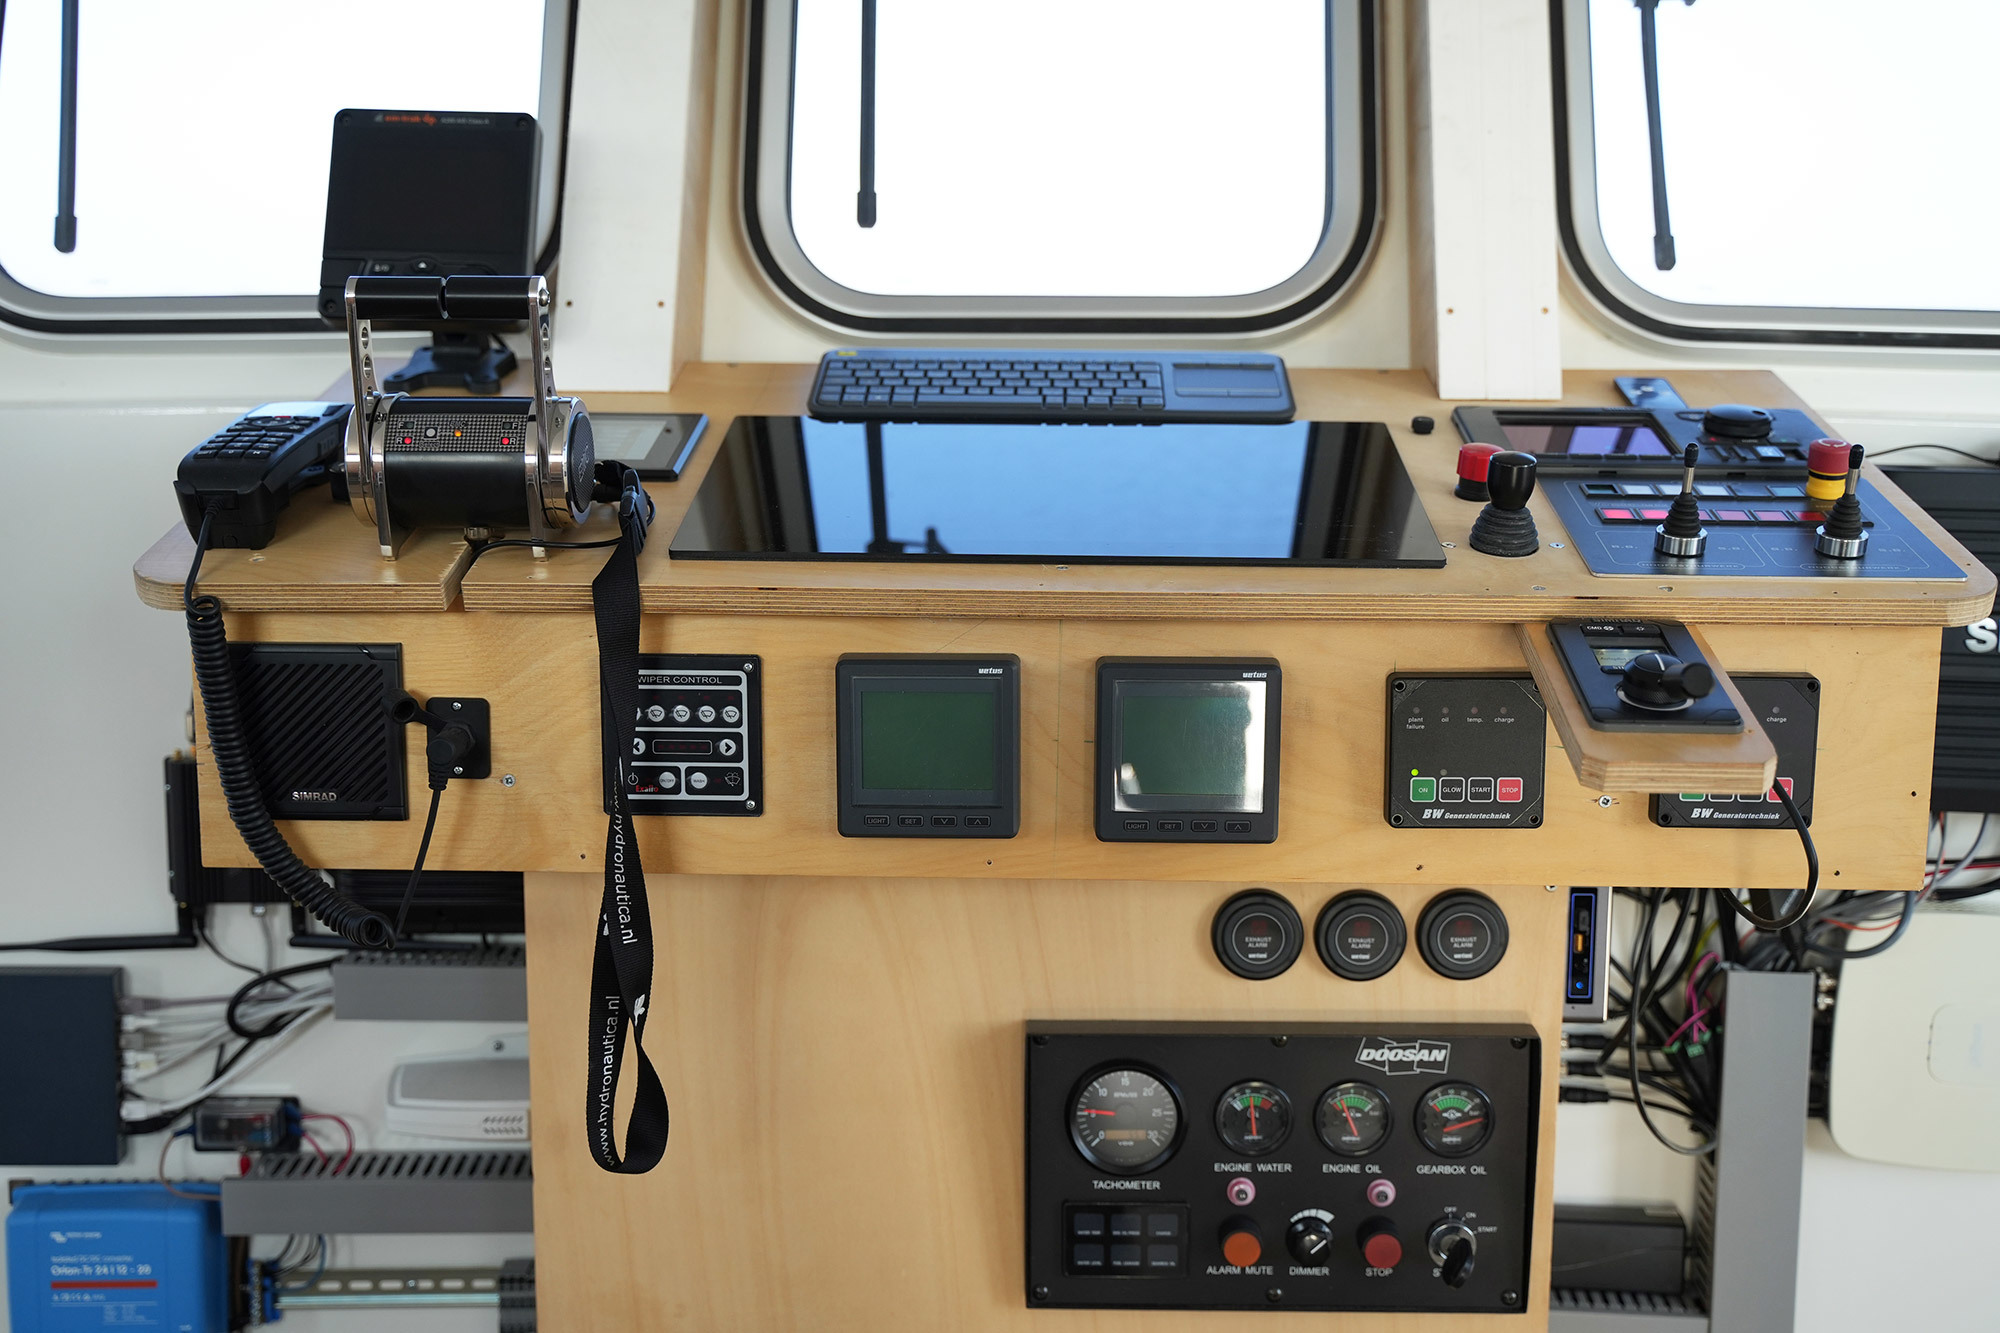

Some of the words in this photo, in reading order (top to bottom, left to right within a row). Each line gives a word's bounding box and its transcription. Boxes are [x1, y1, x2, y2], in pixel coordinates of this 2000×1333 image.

[398, 421, 404, 429] F
[512, 422, 519, 430] F
[509, 437, 517, 445] R
[637, 676, 671, 684] WIPER
[672, 676, 723, 685] CONTROL
[1493, 716, 1515, 724] charge
[1766, 716, 1788, 724] charge
[1442, 786, 1462, 794] GLOW
[1470, 786, 1491, 794] START
[291, 791, 338, 801] SIMRAD
[1422, 808, 1445, 819] BW
[1444, 811, 1512, 820] Generatortechniek
[1690, 807, 1714, 819] BW
[1713, 811, 1781, 820] Generatortechniek
[612, 767, 638, 945] ww.hydronautica.nl
[1245, 936, 1272, 944] EXHAUST
[1348, 936, 1375, 944] EXHAUST
[1450, 936, 1477, 944] EXHAUST
[1359, 1048, 1448, 1062] DOOSAN
[597, 994, 620, 1167] www.hydronautica.nl
[1121, 1077, 1130, 1086] 15
[1098, 1087, 1108, 1097] 10
[1142, 1087, 1155, 1097] 20
[1151, 1108, 1163, 1117] 25
[1098, 1130, 1105, 1139] 0
[1147, 1130, 1159, 1139] 30
[1213, 1162, 1253, 1173] ENGINE
[1256, 1162, 1293, 1173] WATER
[1322, 1163, 1361, 1174] ENGINE
[1365, 1163, 1382, 1174] OIL
[1416, 1164, 1467, 1175] GEARBOX
[1470, 1165, 1488, 1175] OIL
[1092, 1180, 1161, 1190] TACHOMETER
[1206, 1265, 1240, 1275] ALARM
[1245, 1265, 1274, 1275] MUTE
[1289, 1266, 1330, 1276] DIMMER
[1365, 1267, 1393, 1277] STOP
